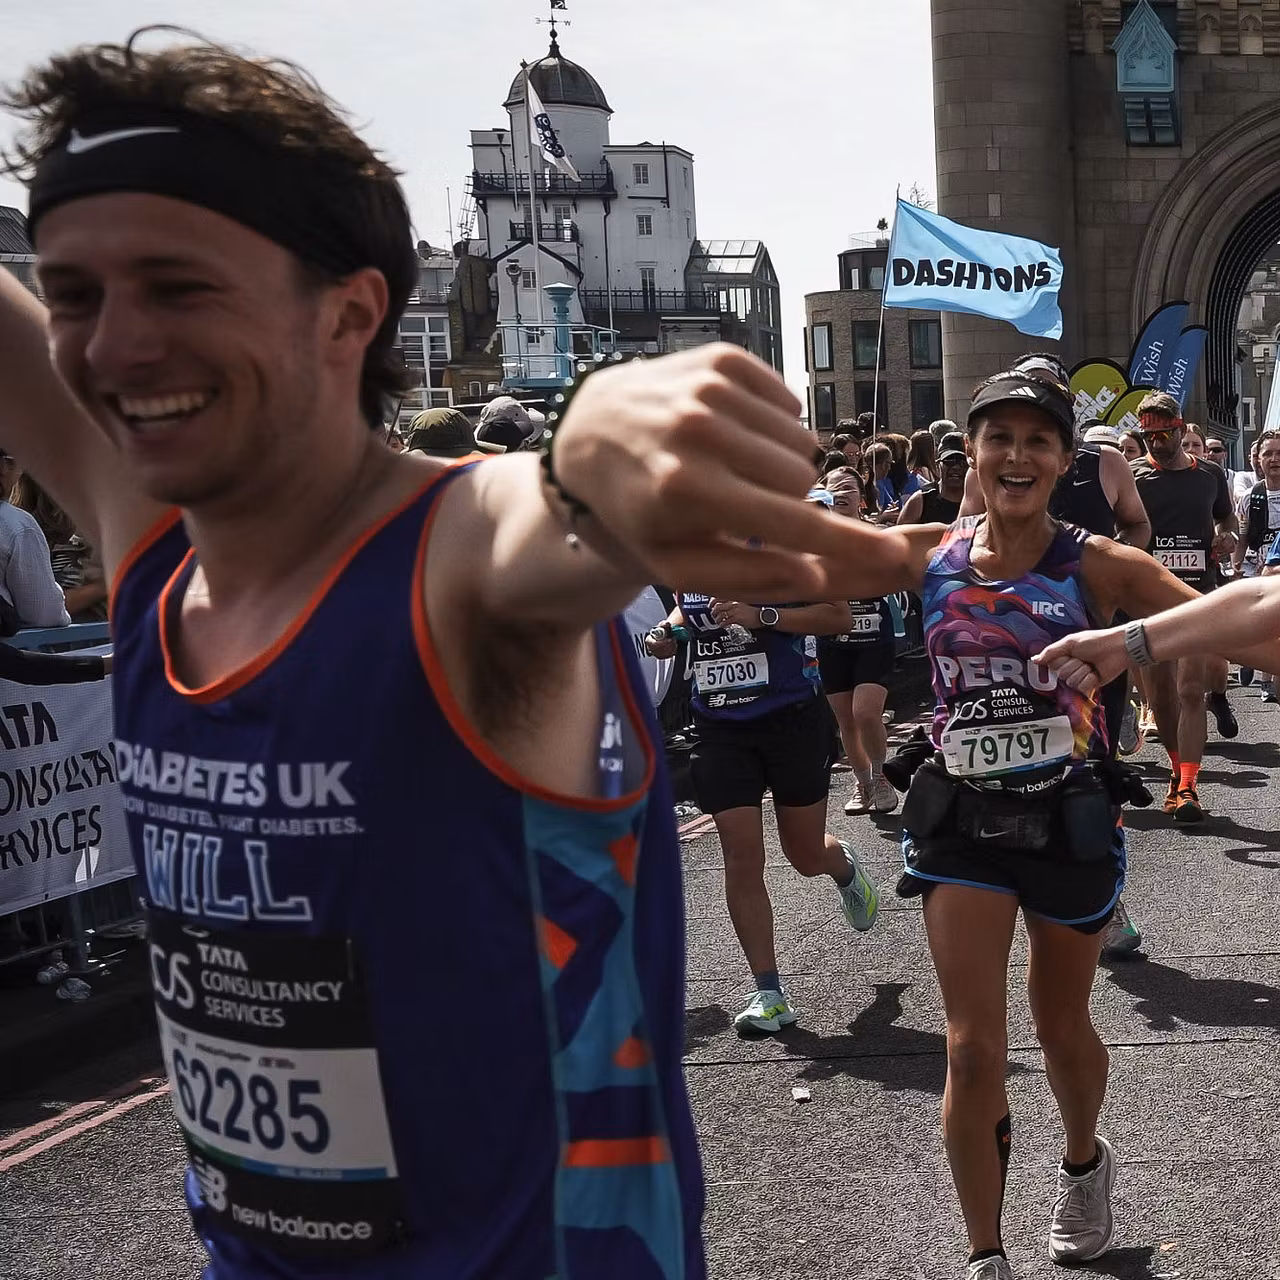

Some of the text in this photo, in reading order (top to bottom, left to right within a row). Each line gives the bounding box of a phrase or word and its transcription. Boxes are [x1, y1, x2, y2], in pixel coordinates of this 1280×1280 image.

[892, 257, 1051, 293] DASHTONS
[1141, 339, 1164, 382] Wish
[1166, 357, 1188, 397] Wish
[1156, 536, 1175, 548] tcs
[1161, 554, 1198, 567] 21112
[1032, 601, 1065, 617] IRC
[697, 639, 721, 657] tcs
[707, 661, 757, 686] 57030
[936, 655, 1058, 692] PERU
[990, 688, 1018, 698] TATA
[993, 706, 1034, 718] SERVICES
[961, 728, 1049, 769] 79797
[277, 761, 356, 808] UK
[0, 805, 102, 870] RVICES
[143, 823, 313, 921] WILL
[196, 943, 248, 971] TATA
[151, 943, 195, 1010] cs
[201, 968, 344, 1002] CONSULTANCY
[203, 995, 286, 1028] SERVICES
[172, 1049, 330, 1155] 62285
[232, 1203, 372, 1240] new balance
